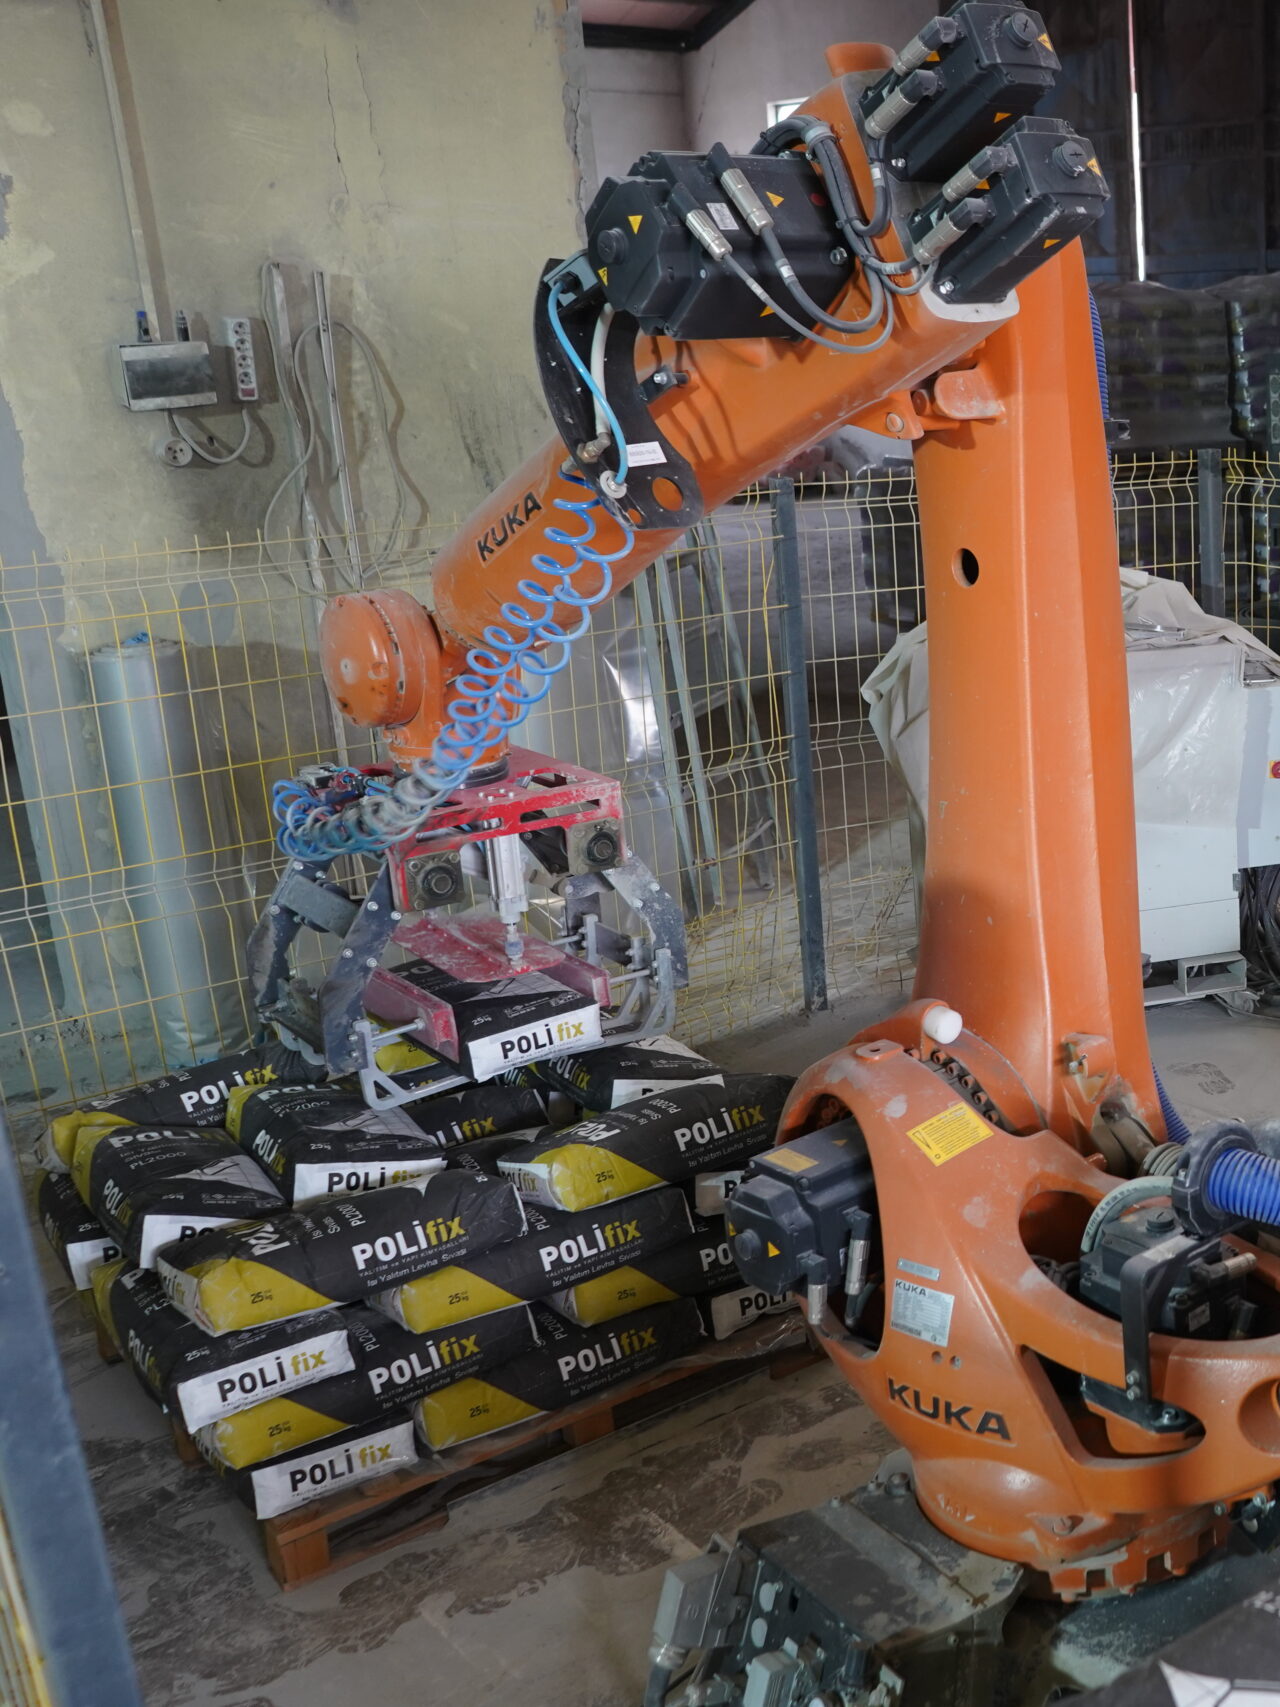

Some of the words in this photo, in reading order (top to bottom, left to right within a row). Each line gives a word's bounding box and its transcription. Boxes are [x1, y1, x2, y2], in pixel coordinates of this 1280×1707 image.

[477, 492, 542, 562] KUKA
[412, 1258, 438, 1273] Levha
[896, 1280, 926, 1296] KUKA
[251, 1291, 264, 1305] 25
[448, 1292, 461, 1305] 25
[617, 1290, 629, 1301] 25
[185, 1350, 199, 1362] 25
[469, 1405, 482, 1418] 25
[888, 1378, 1012, 1441] KUKA
[268, 1426, 282, 1438] 25
